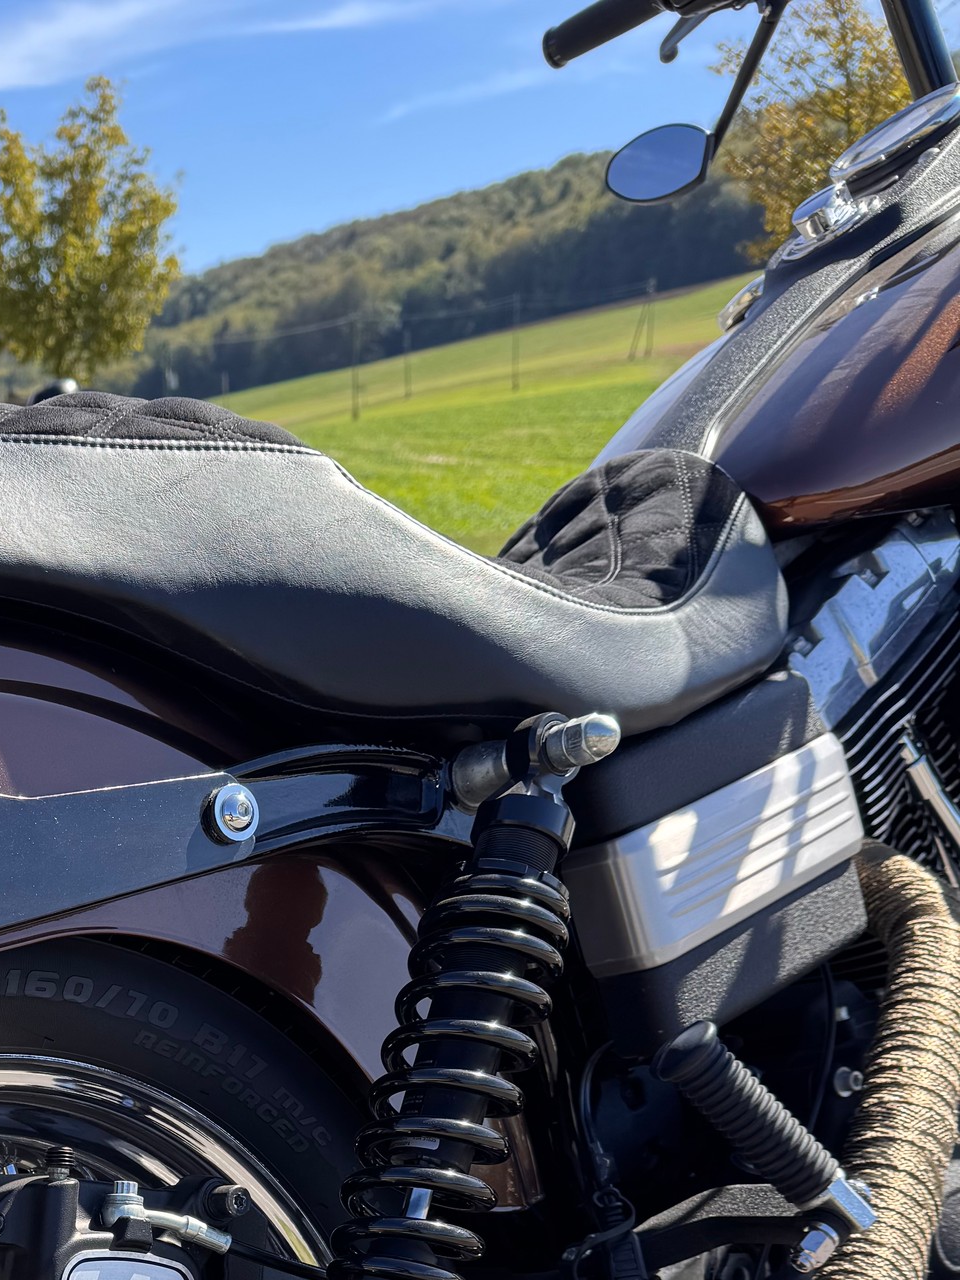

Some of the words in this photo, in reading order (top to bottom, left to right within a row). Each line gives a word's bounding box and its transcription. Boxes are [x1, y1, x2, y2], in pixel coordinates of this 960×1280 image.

[3, 968, 180, 1030] 160/70
[191, 1021, 269, 1081] B17
[131, 1029, 311, 1154] REINFORCED
